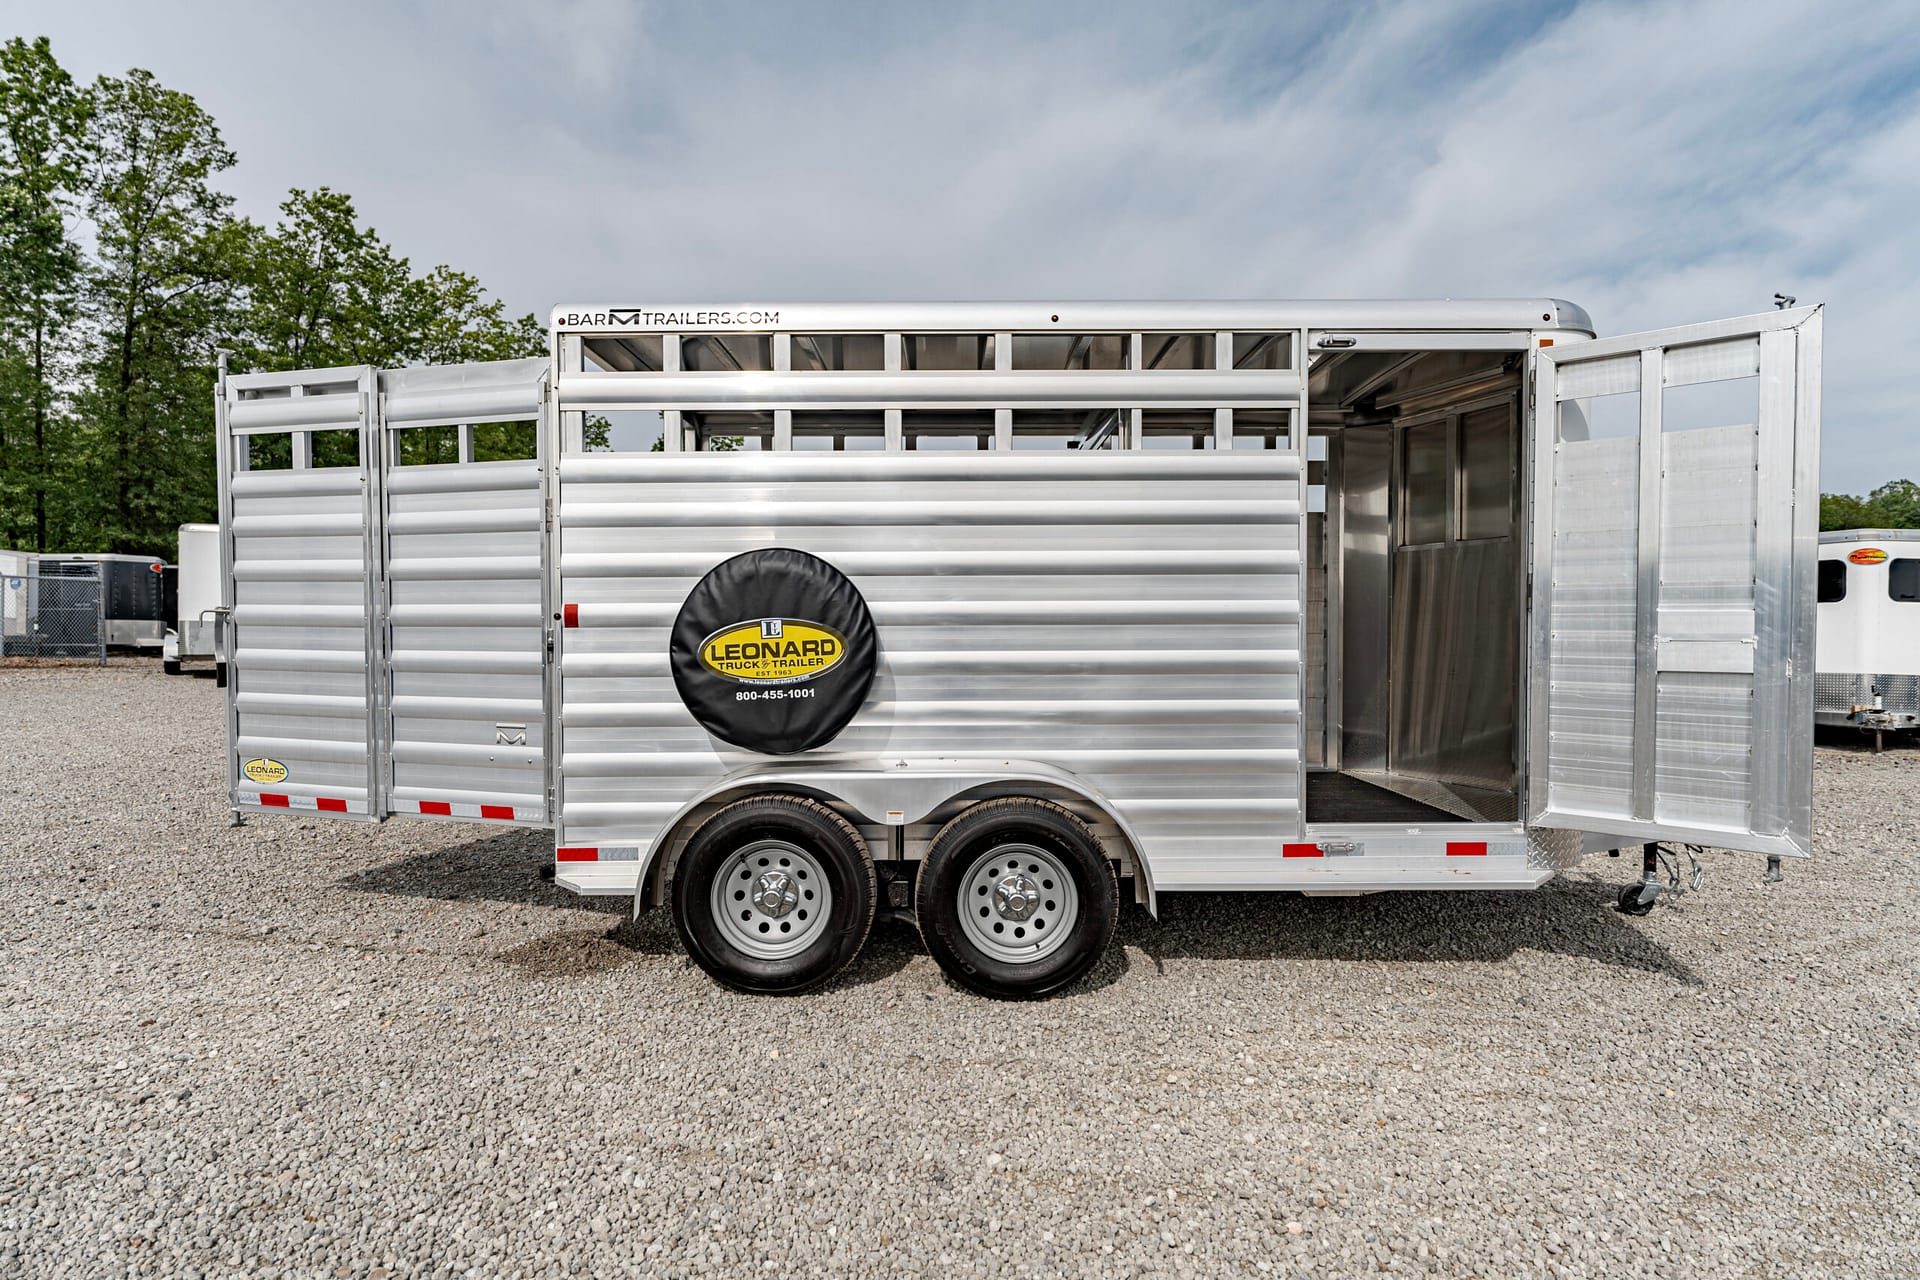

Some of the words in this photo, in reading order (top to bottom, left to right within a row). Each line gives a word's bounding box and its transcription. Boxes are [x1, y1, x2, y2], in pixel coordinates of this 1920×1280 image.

[711, 639, 835, 661] LEONARD
[718, 660, 760, 670] TRUCK
[760, 659, 770, 669] &
[771, 658, 824, 668] TRAILER
[735, 688, 815, 701] 800-455-1001
[246, 766, 285, 775] LEONARD
